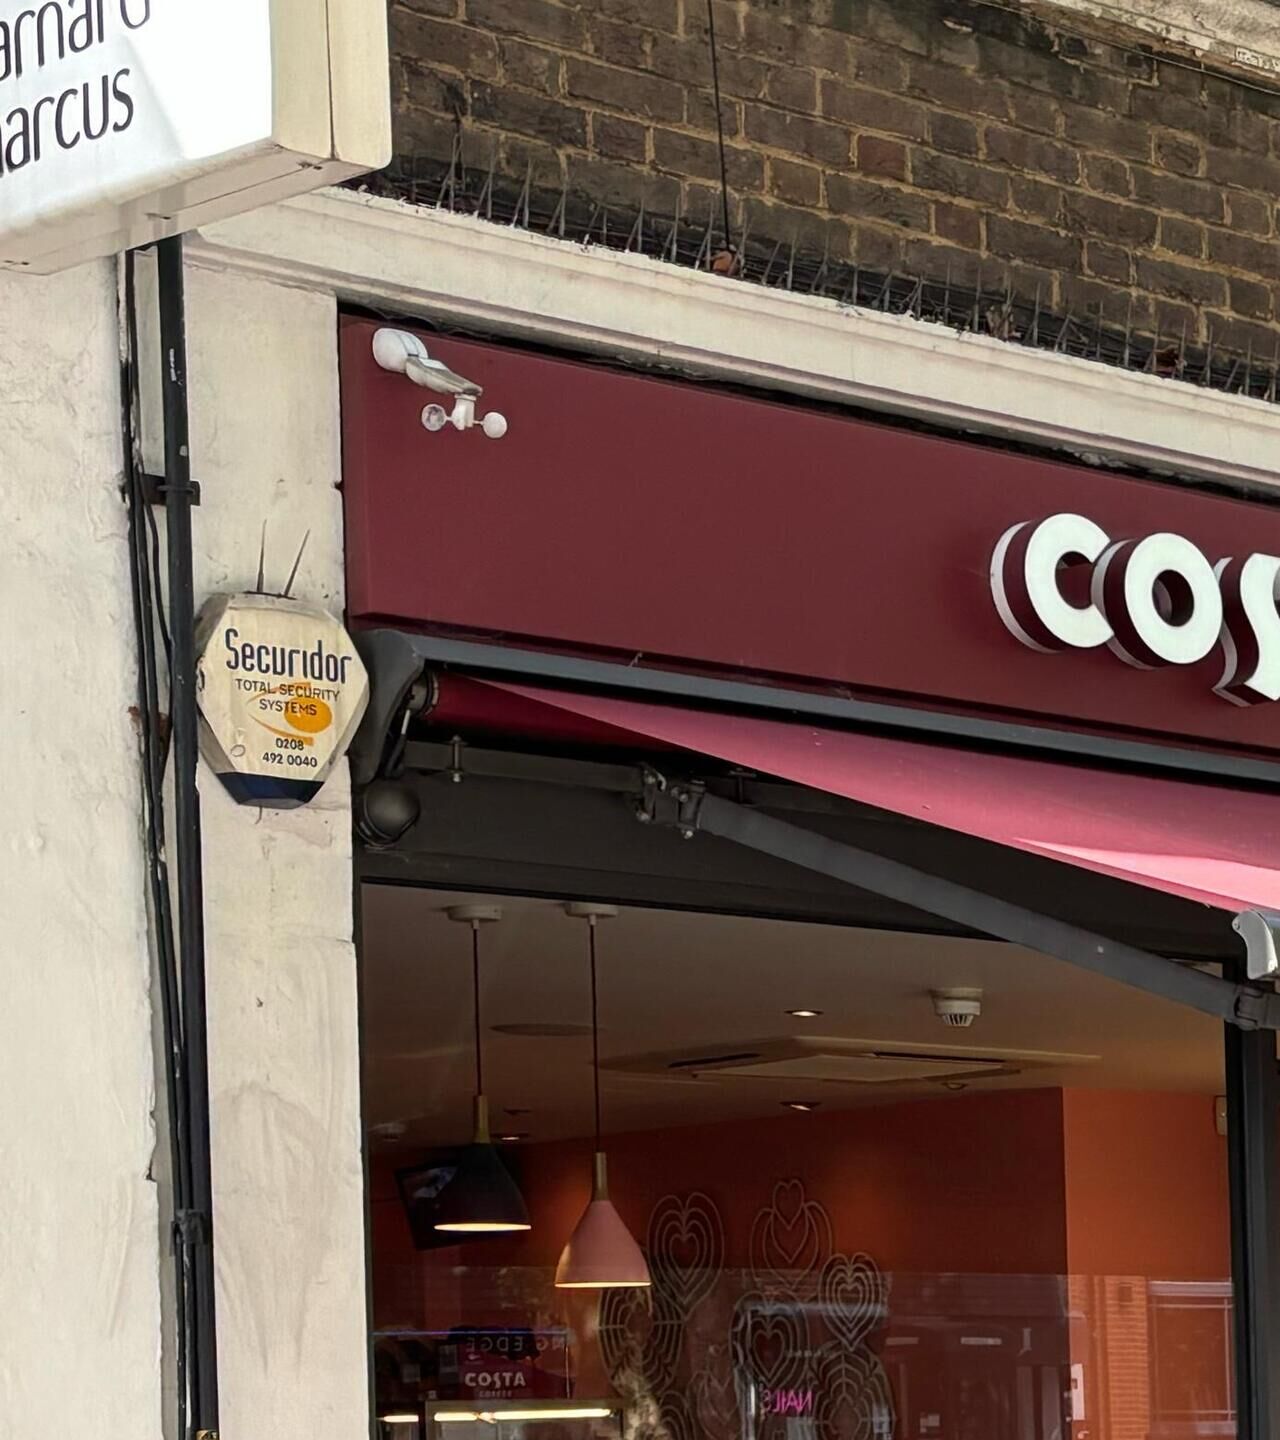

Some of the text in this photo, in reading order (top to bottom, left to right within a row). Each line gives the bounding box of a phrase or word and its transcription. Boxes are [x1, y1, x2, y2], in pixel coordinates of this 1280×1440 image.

[0, 68, 134, 178] arcus
[225, 628, 352, 684] Securidor
[235, 678, 341, 702] TOTAL SECURITY
[259, 698, 318, 716] SYSTEMS
[275, 738, 305, 751] 0208
[262, 753, 318, 768] 492 0040
[464, 1371, 527, 1389] COSTA
